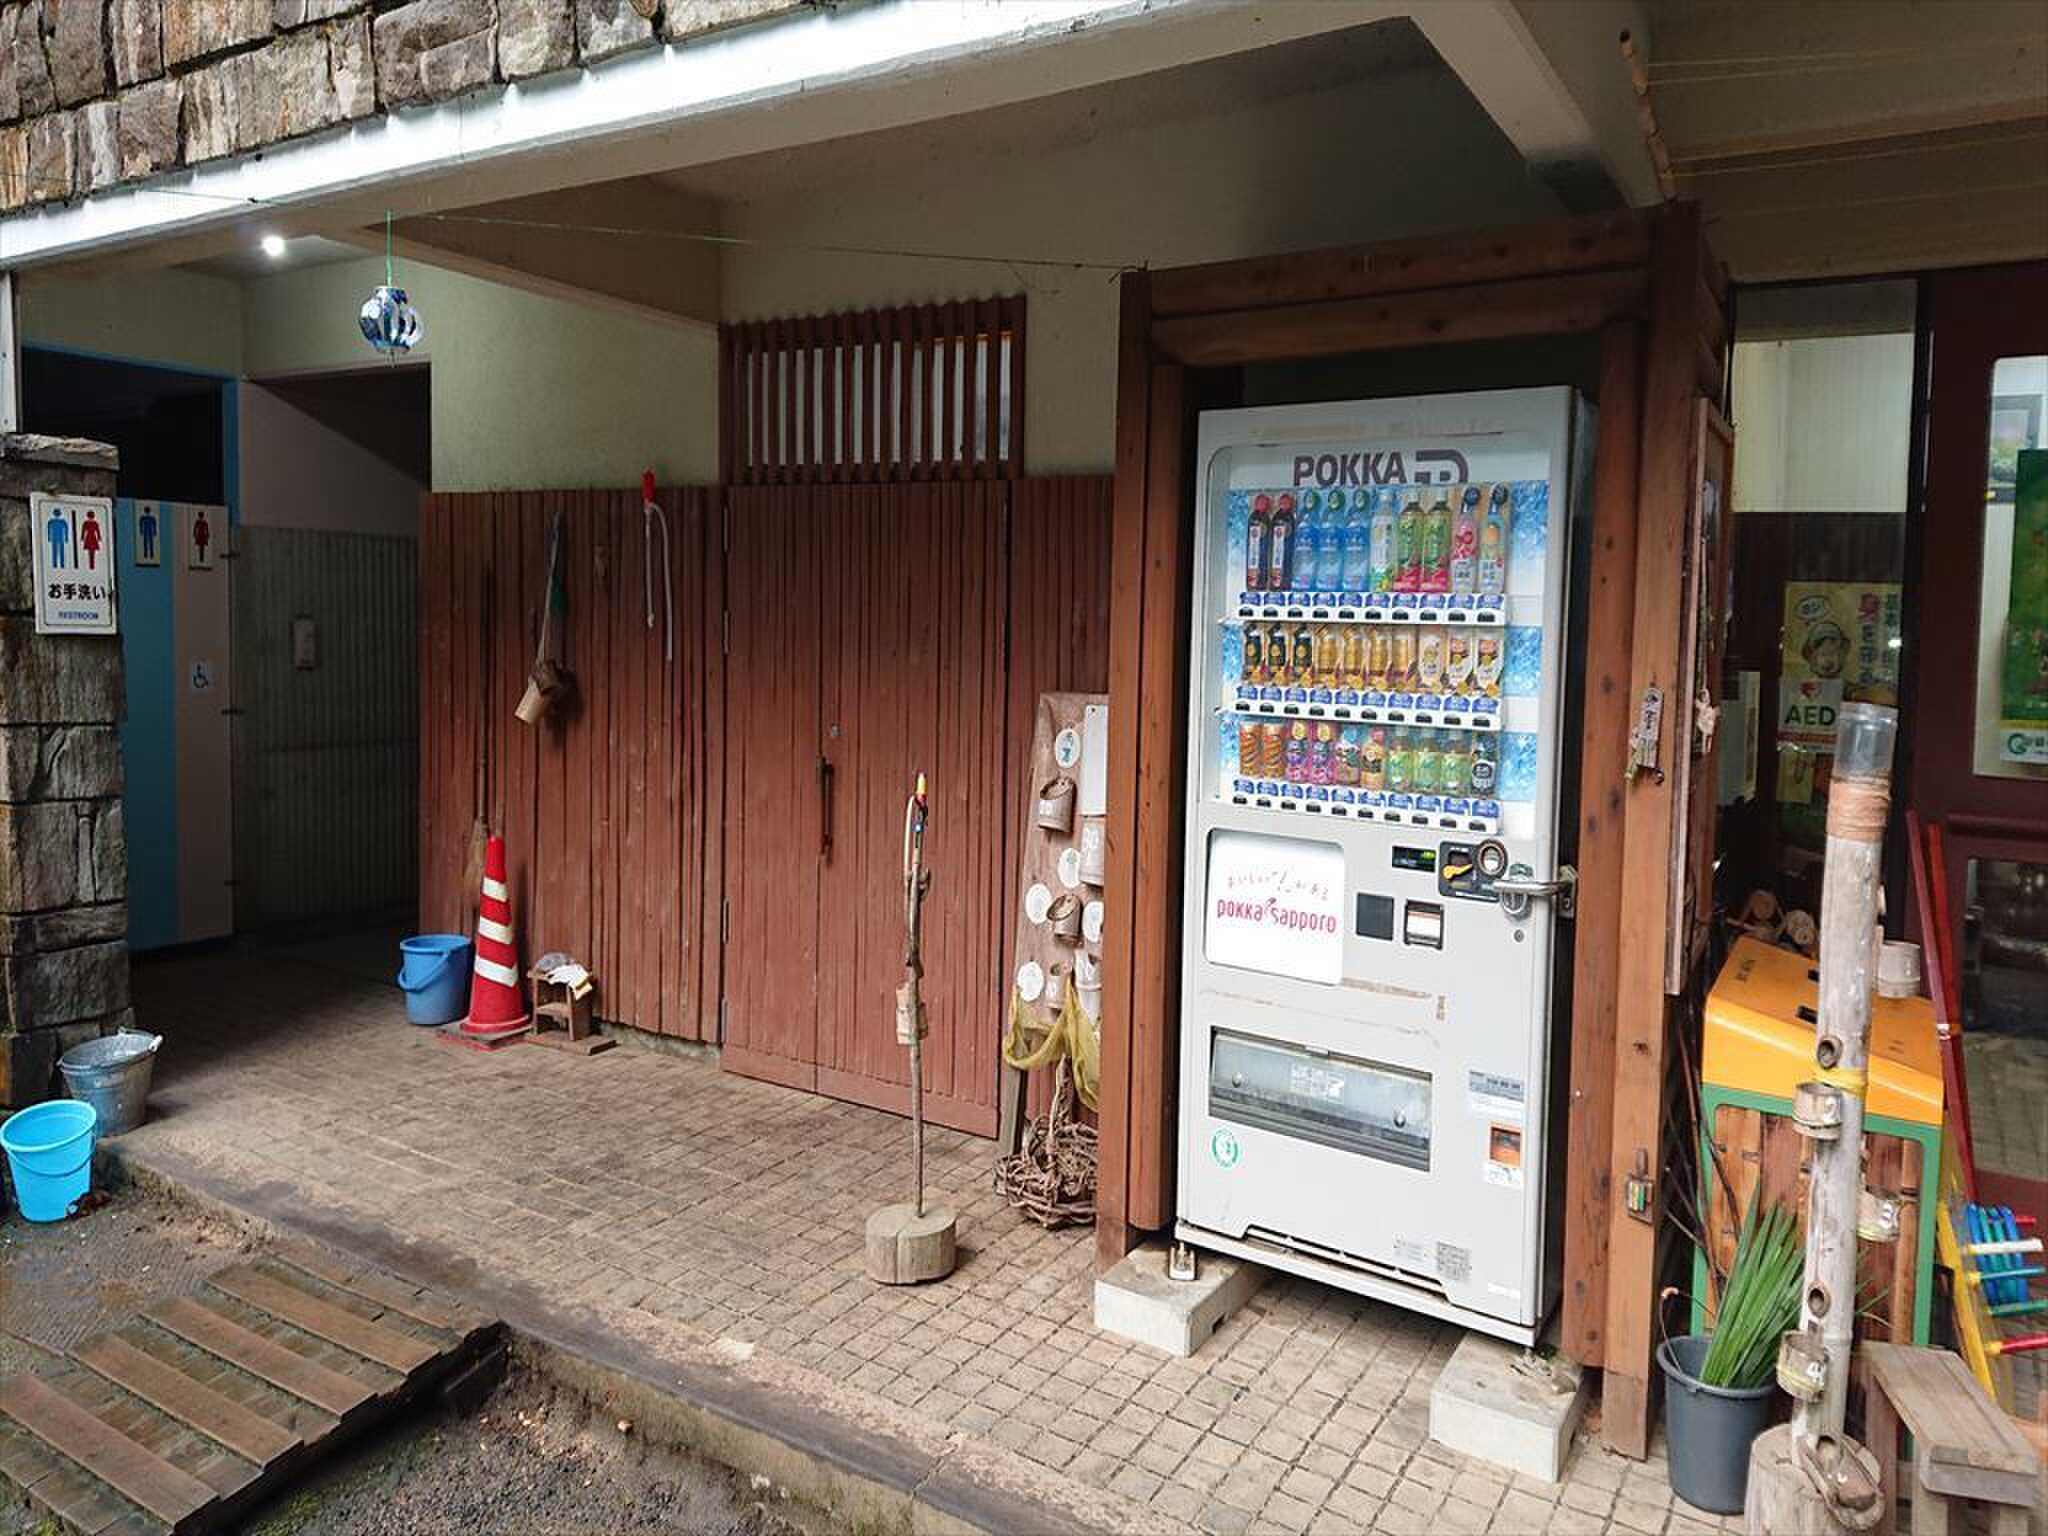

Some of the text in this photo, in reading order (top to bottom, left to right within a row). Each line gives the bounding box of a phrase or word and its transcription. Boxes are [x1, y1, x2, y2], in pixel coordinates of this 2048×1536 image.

[1293, 451, 1408, 488] POKKA
[48, 583, 106, 601] お手洗い
[1784, 704, 1836, 726] AED
